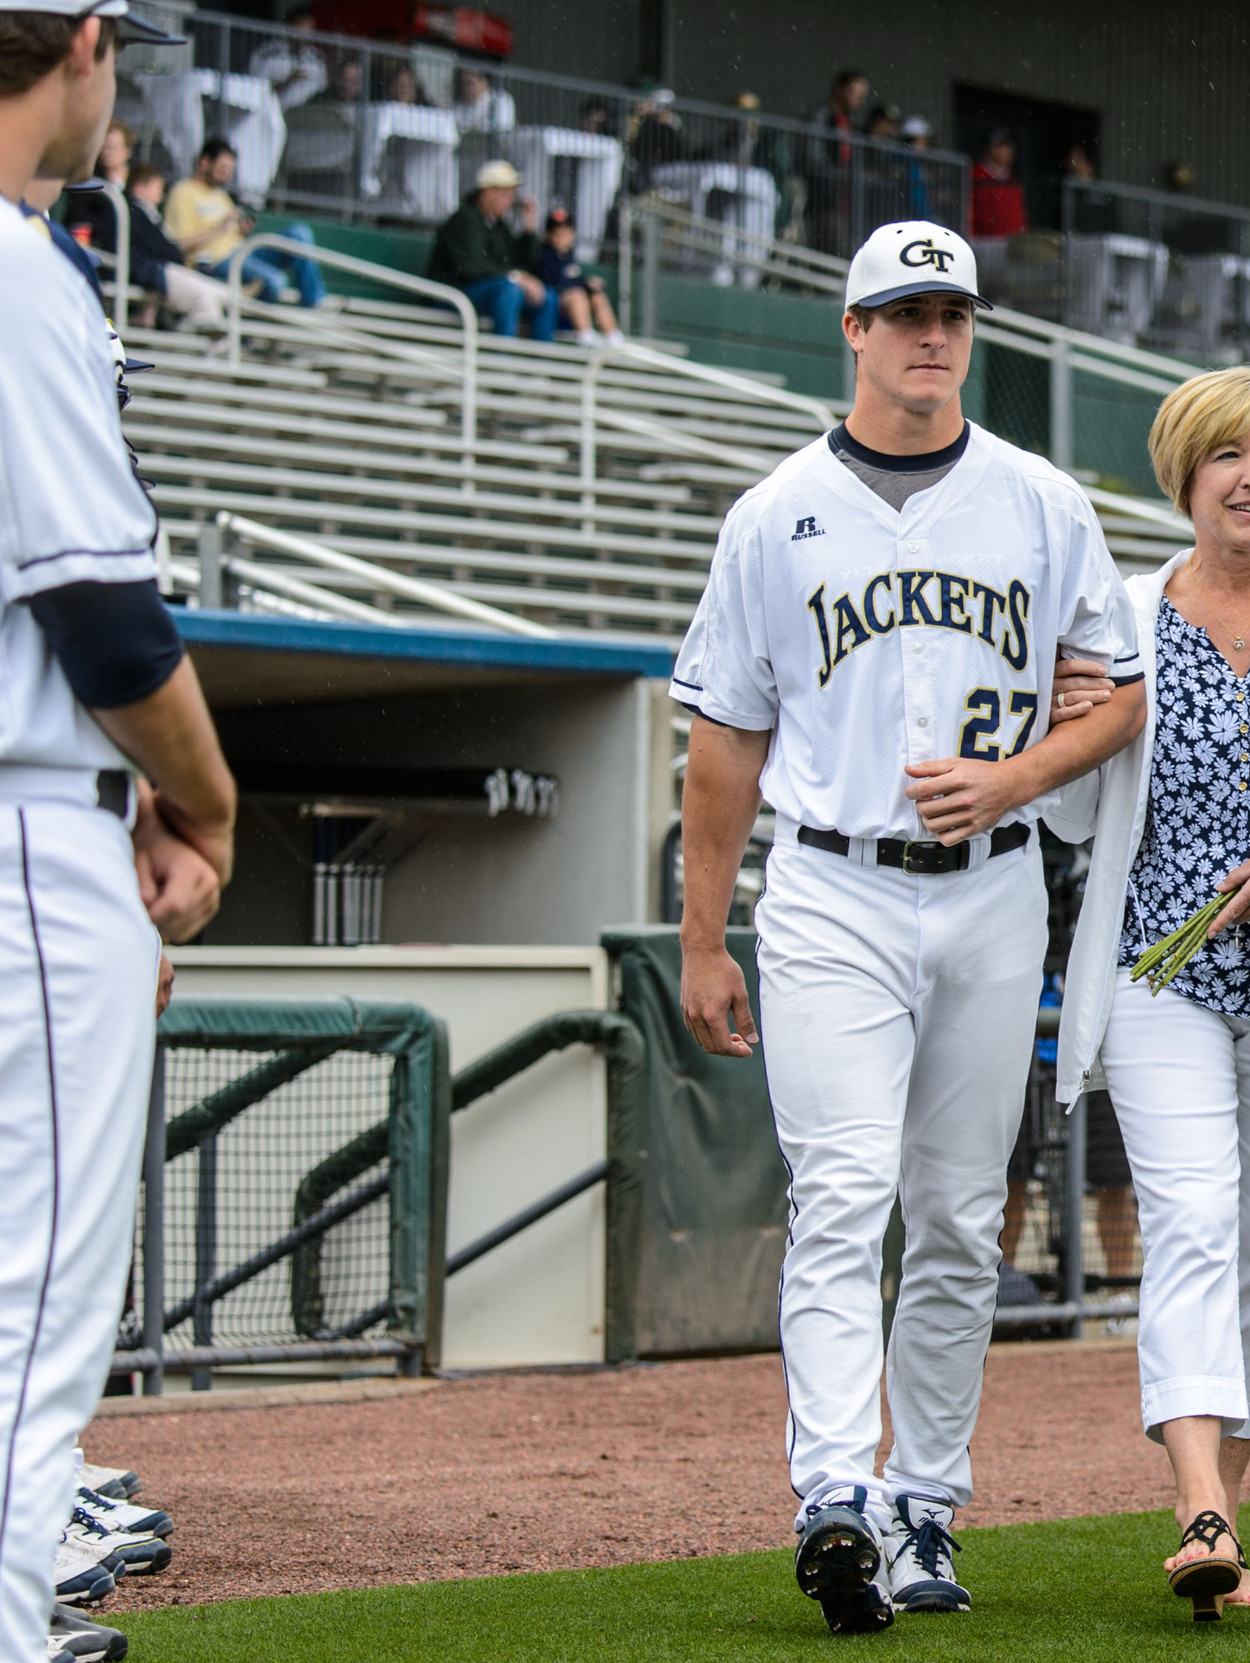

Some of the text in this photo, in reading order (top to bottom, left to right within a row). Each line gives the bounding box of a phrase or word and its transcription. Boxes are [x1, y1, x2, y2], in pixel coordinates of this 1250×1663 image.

[899, 238, 955, 273] GT
[791, 529, 827, 541] RUSSELL
[808, 569, 1031, 690] JACKETS
[957, 686, 1038, 763] 27
